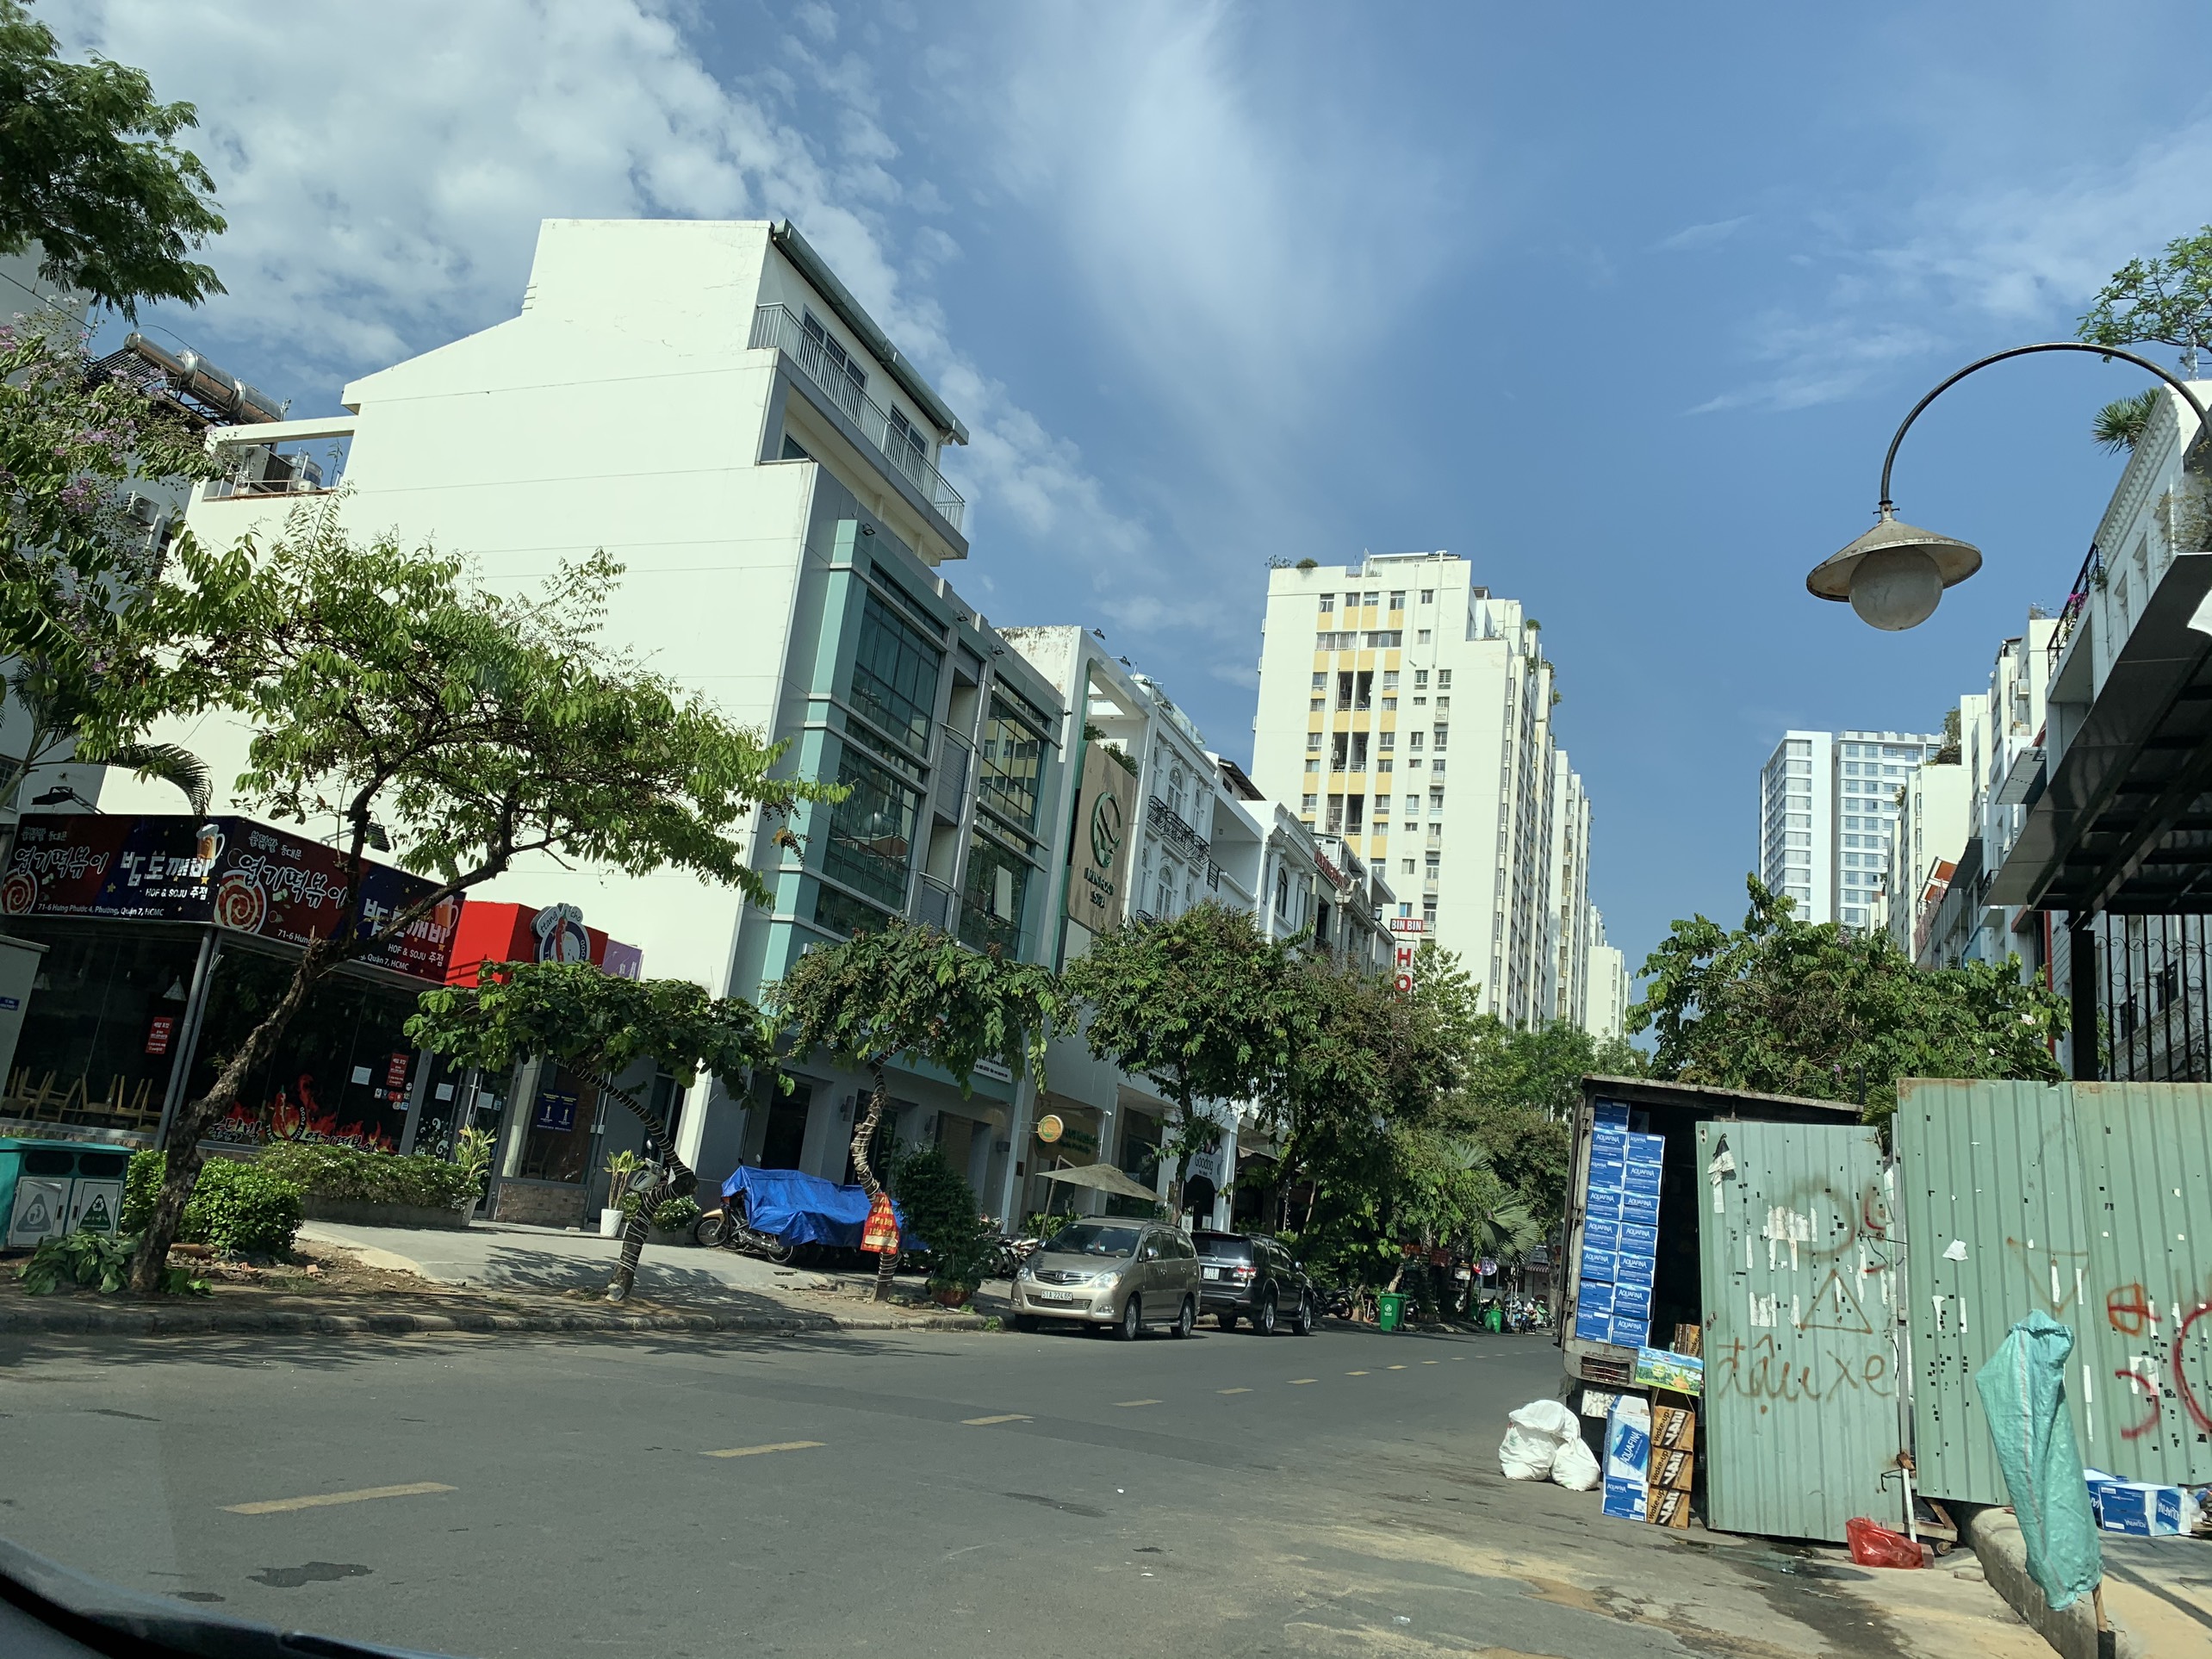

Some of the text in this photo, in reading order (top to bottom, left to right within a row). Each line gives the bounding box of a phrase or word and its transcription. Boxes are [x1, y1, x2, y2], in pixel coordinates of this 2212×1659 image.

[281, 845, 302, 861] 동대문
[146, 886, 208, 900] HOF & SOJU 주점
[38, 903, 52, 911] 71-6
[145, 908, 165, 916] HCMC
[1391, 919, 1421, 931] BIN BIN
[277, 929, 294, 941] 71-6
[388, 943, 444, 967] HOF & SOJU 주점
[390, 959, 409, 971] HCMC
[1394, 948, 1412, 1003] HO
[1596, 1134, 1620, 1143] AQUAFINA
[1630, 1167, 1655, 1177] AQUAFINA
[1590, 1192, 1615, 1203] AQUAFINA
[1628, 1197, 1652, 1208] AQUAFINA
[1588, 1222, 1612, 1233] AQUAFINA
[1625, 1227, 1650, 1238] AQUAFINA
[1584, 1253, 1609, 1264] AQUAFINA
[1622, 1258, 1647, 1269] AQUAFINA
[1618, 1289, 1643, 1301] AQUAFINA
[1618, 1320, 1643, 1331] AQUAFINA
[1825, 1355, 1893, 1403] xe
[1664, 1410, 1687, 1445] 247
[1619, 1431, 1643, 1464] AQUAFINA
[1662, 1451, 1684, 1485] 247
[1606, 1483, 1627, 1494] AQUAFINA
[1658, 1490, 1681, 1524] 247
